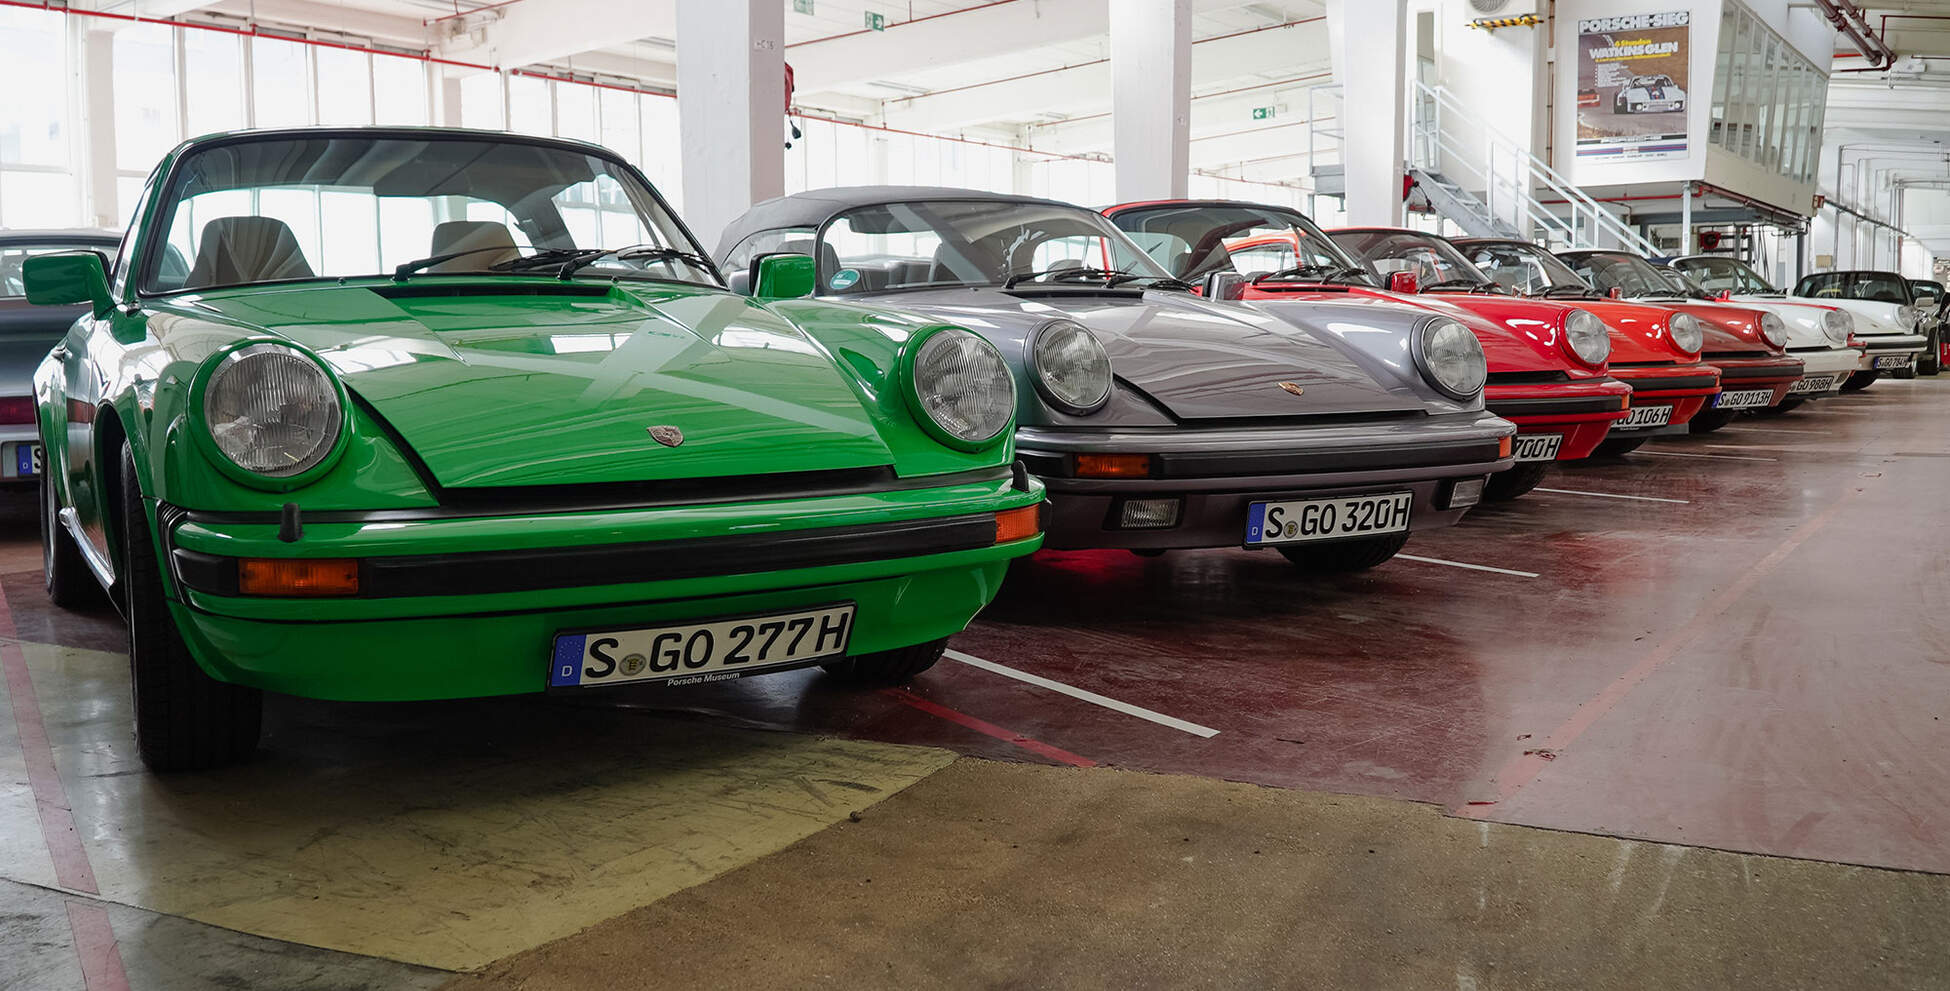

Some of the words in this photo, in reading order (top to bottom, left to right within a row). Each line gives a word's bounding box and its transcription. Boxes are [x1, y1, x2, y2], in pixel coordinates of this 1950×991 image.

[1796, 379, 1809, 390] GO
[1718, 393, 1727, 406] S
[1730, 392, 1744, 406] GO
[1744, 391, 1772, 405] 9113H
[1635, 408, 1672, 425] 106H
[1251, 527, 1259, 536] D
[1265, 507, 1285, 538] S
[1301, 504, 1337, 536] GO
[1341, 497, 1411, 533] 320H
[561, 665, 573, 677] D
[585, 638, 620, 679] S
[650, 629, 716, 673] GO
[723, 612, 850, 665] 277H
[667, 677, 702, 687] Porsche
[703, 672, 740, 682] Museum
